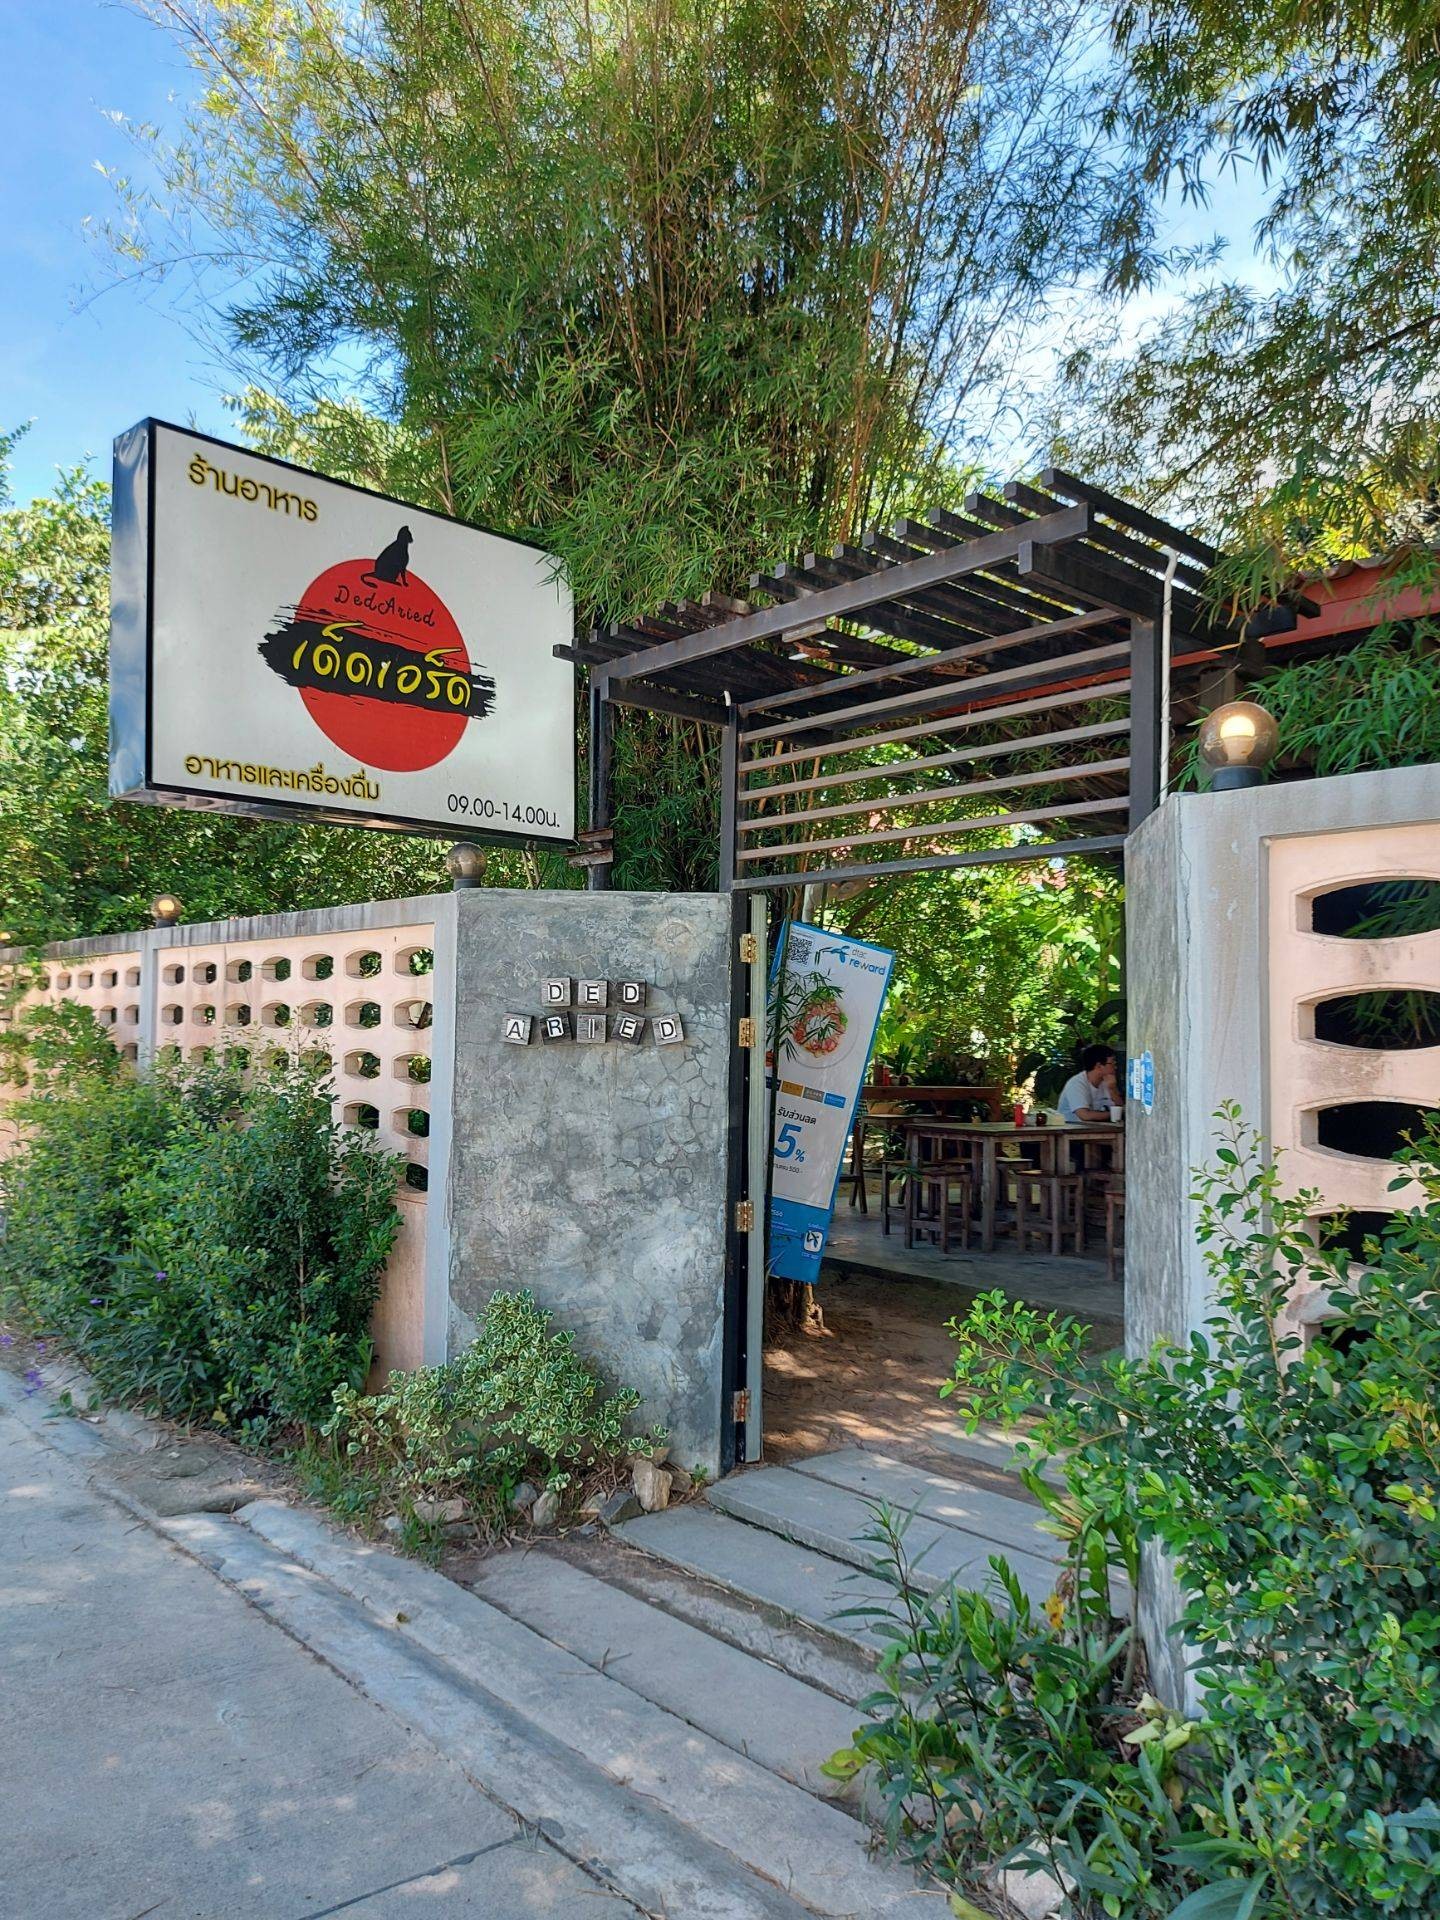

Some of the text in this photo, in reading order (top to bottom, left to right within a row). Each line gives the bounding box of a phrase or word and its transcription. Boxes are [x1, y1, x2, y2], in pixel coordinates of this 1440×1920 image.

[188, 452, 319, 522] ร้านอาหาร
[292, 621, 471, 709] เด็ดเอร็ด
[185, 755, 380, 800] อาหารและเครื่องดื่ม
[447, 793, 561, 828] 09.00-14.00น.
[849, 958, 887, 976] reward
[546, 981, 641, 1004] DED
[504, 1015, 679, 1041] ARIED
[776, 1106, 817, 1125] รับส่วนลด
[773, 1122, 805, 1163] 5%
